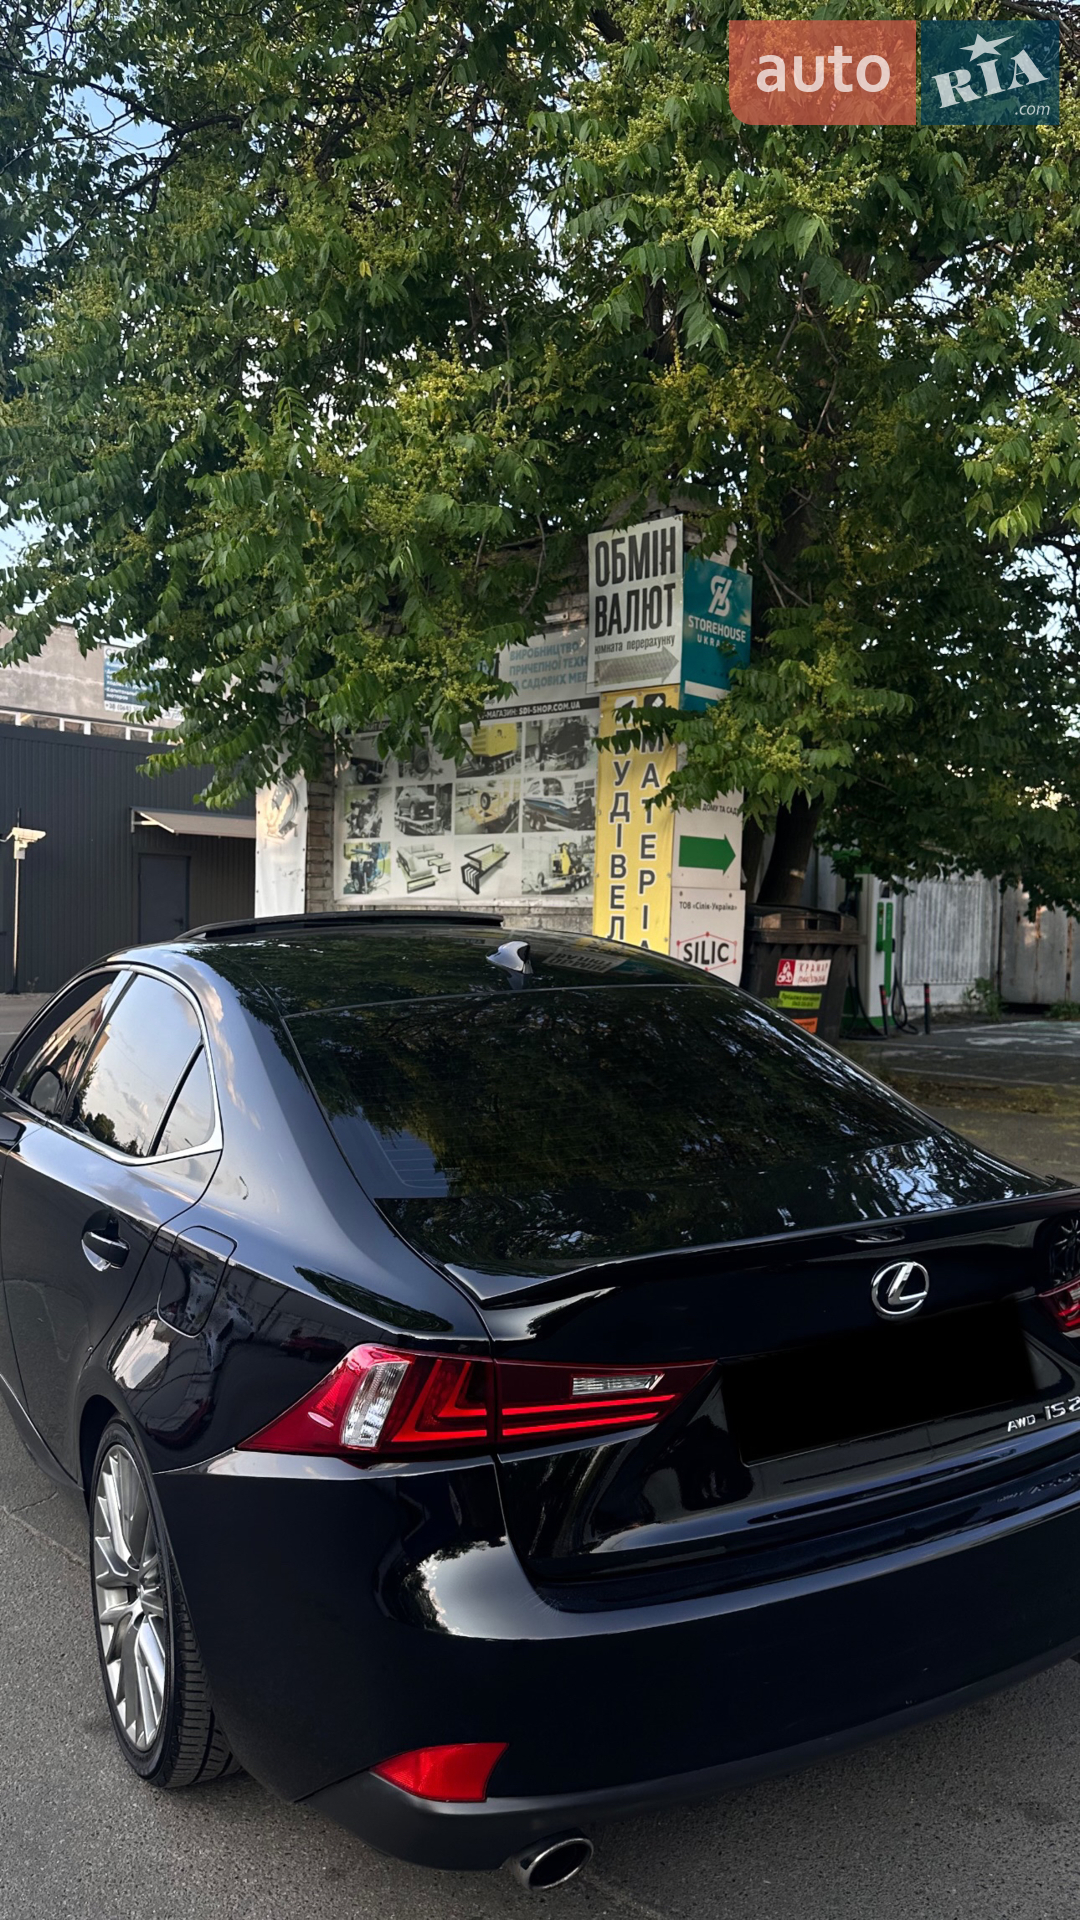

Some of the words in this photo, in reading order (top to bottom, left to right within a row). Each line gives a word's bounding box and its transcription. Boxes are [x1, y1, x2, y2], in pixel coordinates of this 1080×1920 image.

[594, 526, 676, 588] ОБМІН
[594, 583, 676, 638] ВАЛЮТ
[688, 614, 747, 643] STOREHOUSE
[510, 641, 580, 661] ВИРОБНИЦТВО
[594, 642, 623, 655] кімната
[626, 635, 676, 651] перерахунку
[509, 658, 562, 677] ПРИЧЕПНОЇ
[521, 673, 567, 690] САДОВИХ
[519, 701, 581, 715] SDI-SHOP.COM.UA
[727, 806, 738, 815] САД
[679, 901, 691, 910] ТОВ
[683, 940, 729, 965] SILIC
[1007, 1414, 1036, 1432] AWD
